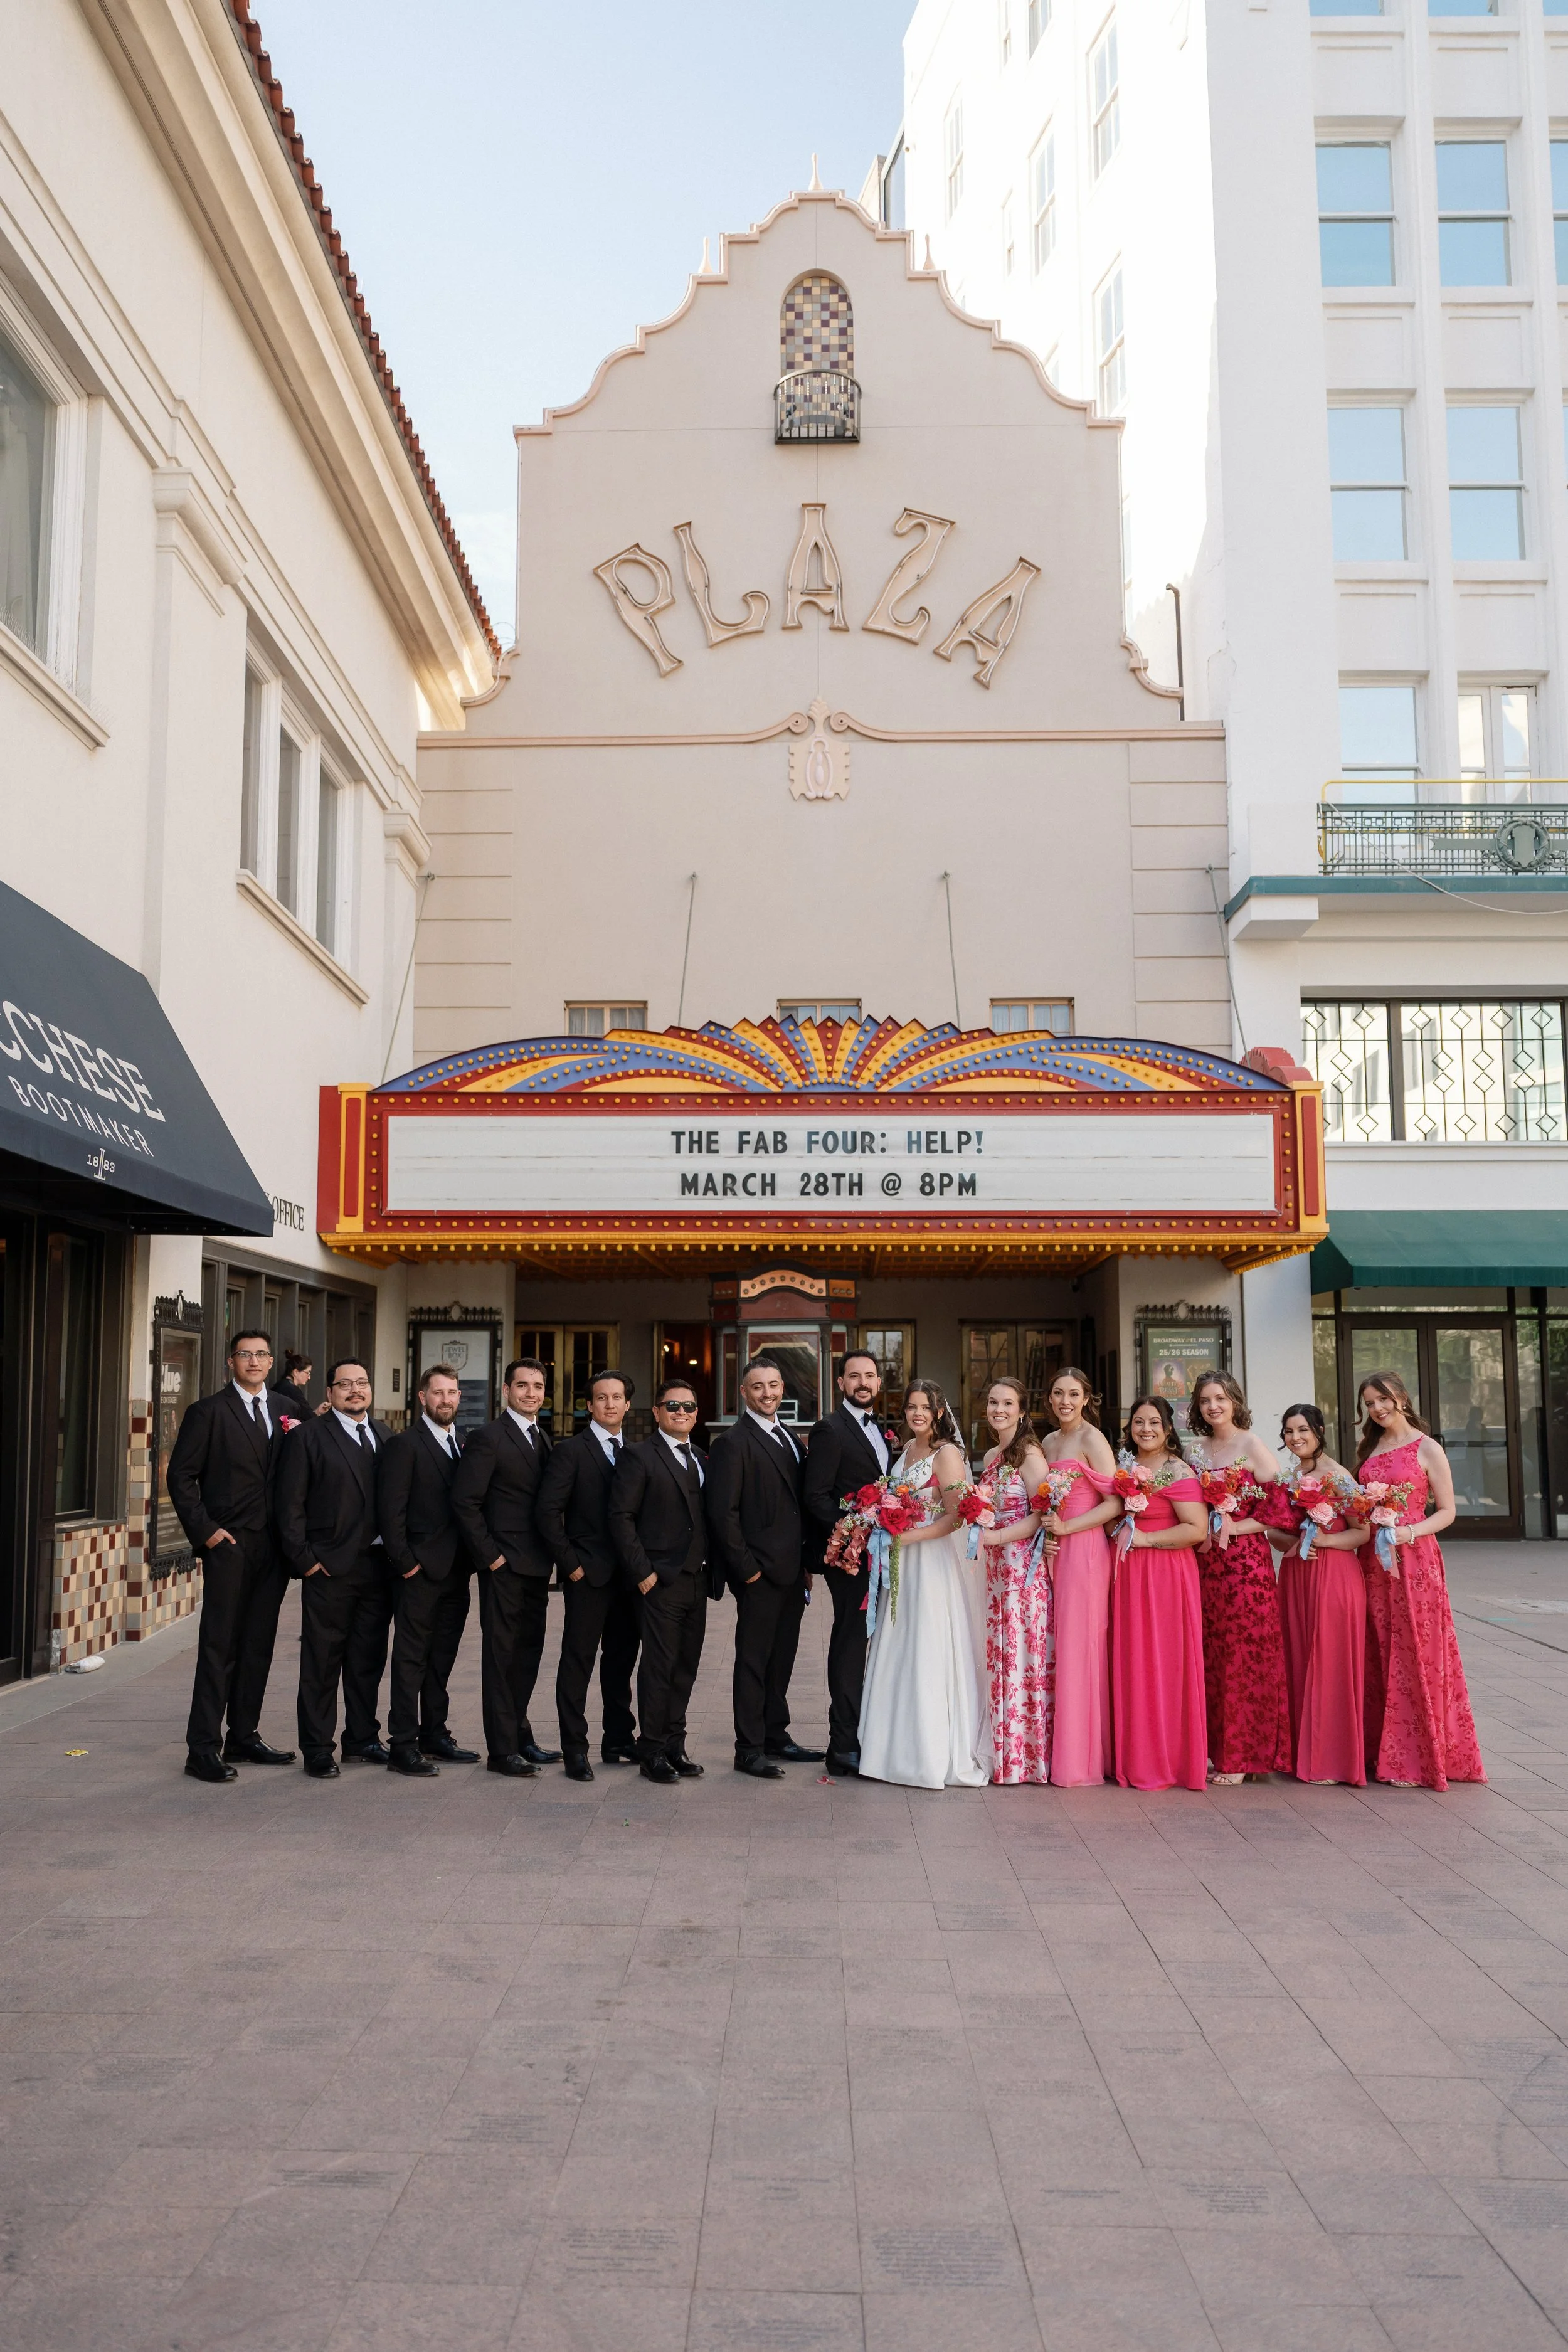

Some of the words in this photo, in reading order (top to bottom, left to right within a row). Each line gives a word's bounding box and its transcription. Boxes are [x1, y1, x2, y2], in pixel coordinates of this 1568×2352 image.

[593, 502, 1042, 689] PLAZA
[8, 1076, 154, 1157] BOOTMAKER
[670, 1131, 719, 1154] THE
[738, 1131, 788, 1154] FAB
[807, 1131, 886, 1154] FOUR:
[908, 1131, 983, 1154] HELP!
[681, 1173, 776, 1196] MARCH
[800, 1173, 863, 1196] 28TH
[881, 1173, 901, 1196] @
[920, 1173, 977, 1196] 8PM
[272, 1196, 304, 1231] OFFICE
